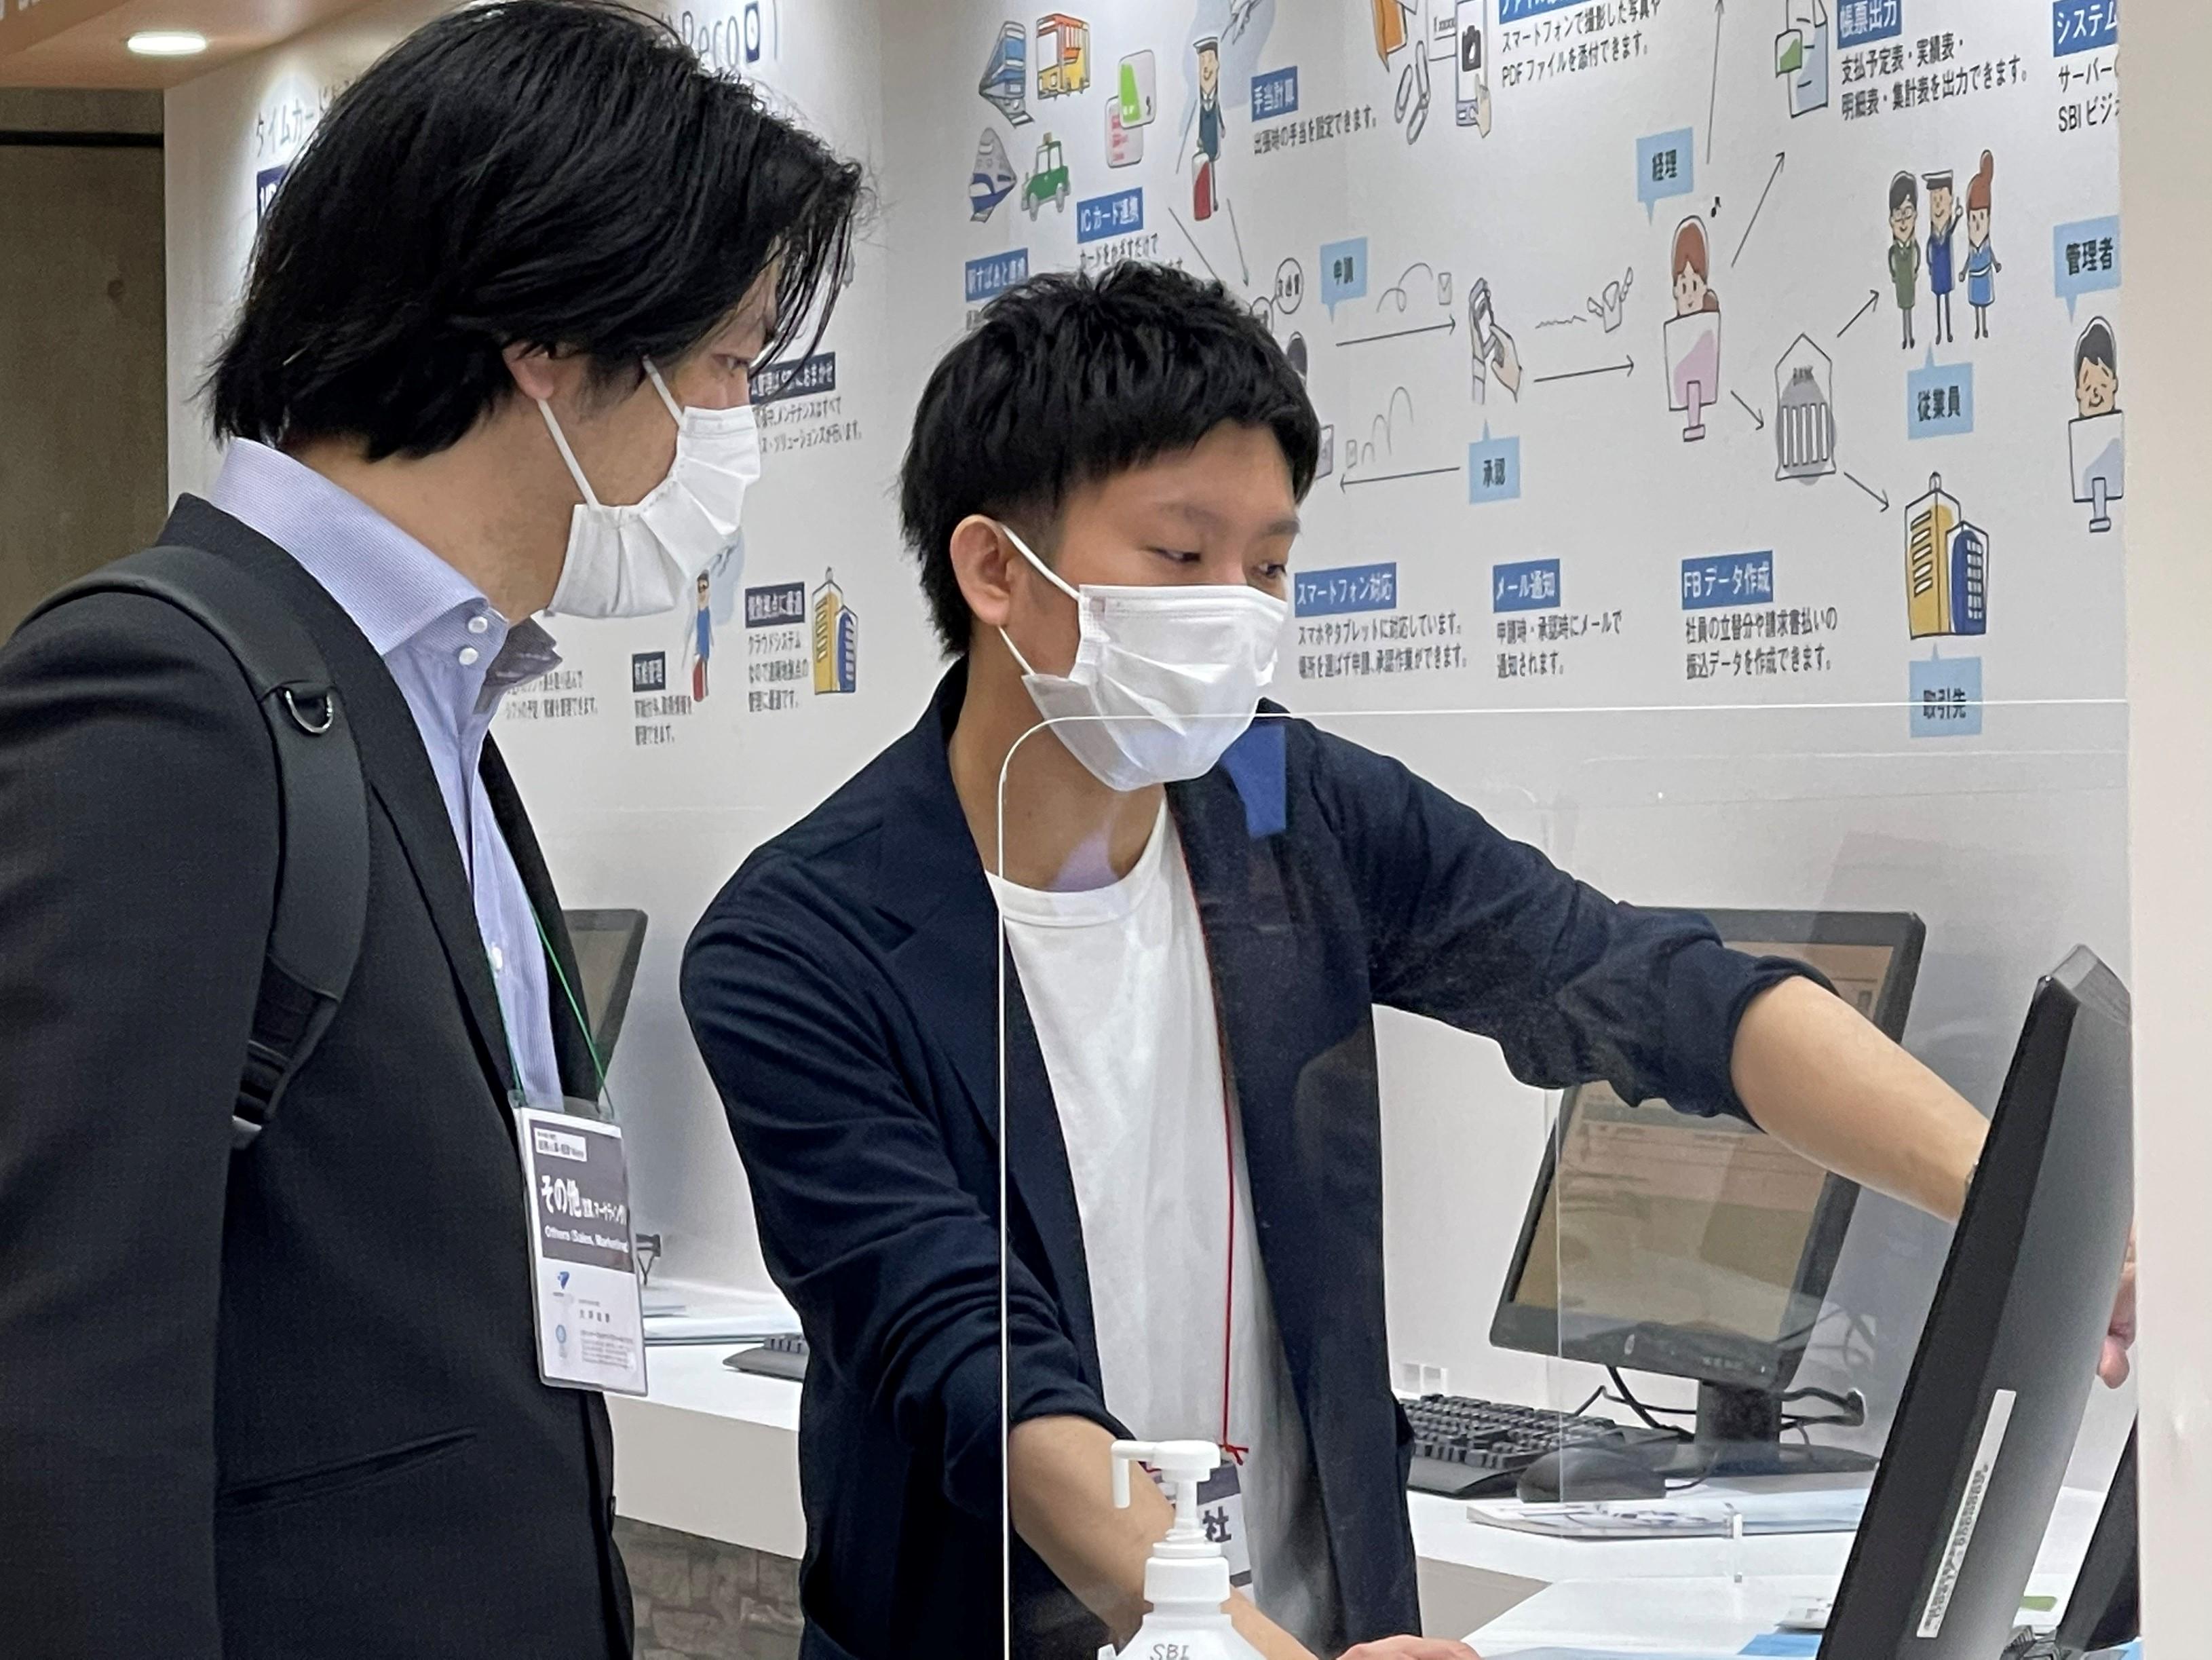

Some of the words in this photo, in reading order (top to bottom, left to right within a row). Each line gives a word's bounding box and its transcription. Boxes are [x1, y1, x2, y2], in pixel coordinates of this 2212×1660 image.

[1839, 0, 1897, 38] 帳票出力
[1652, 149, 1677, 182] 経理
[2065, 238, 2114, 276] 管理者
[1918, 385, 1960, 422] 従業員
[1923, 687, 1966, 719] 取引先
